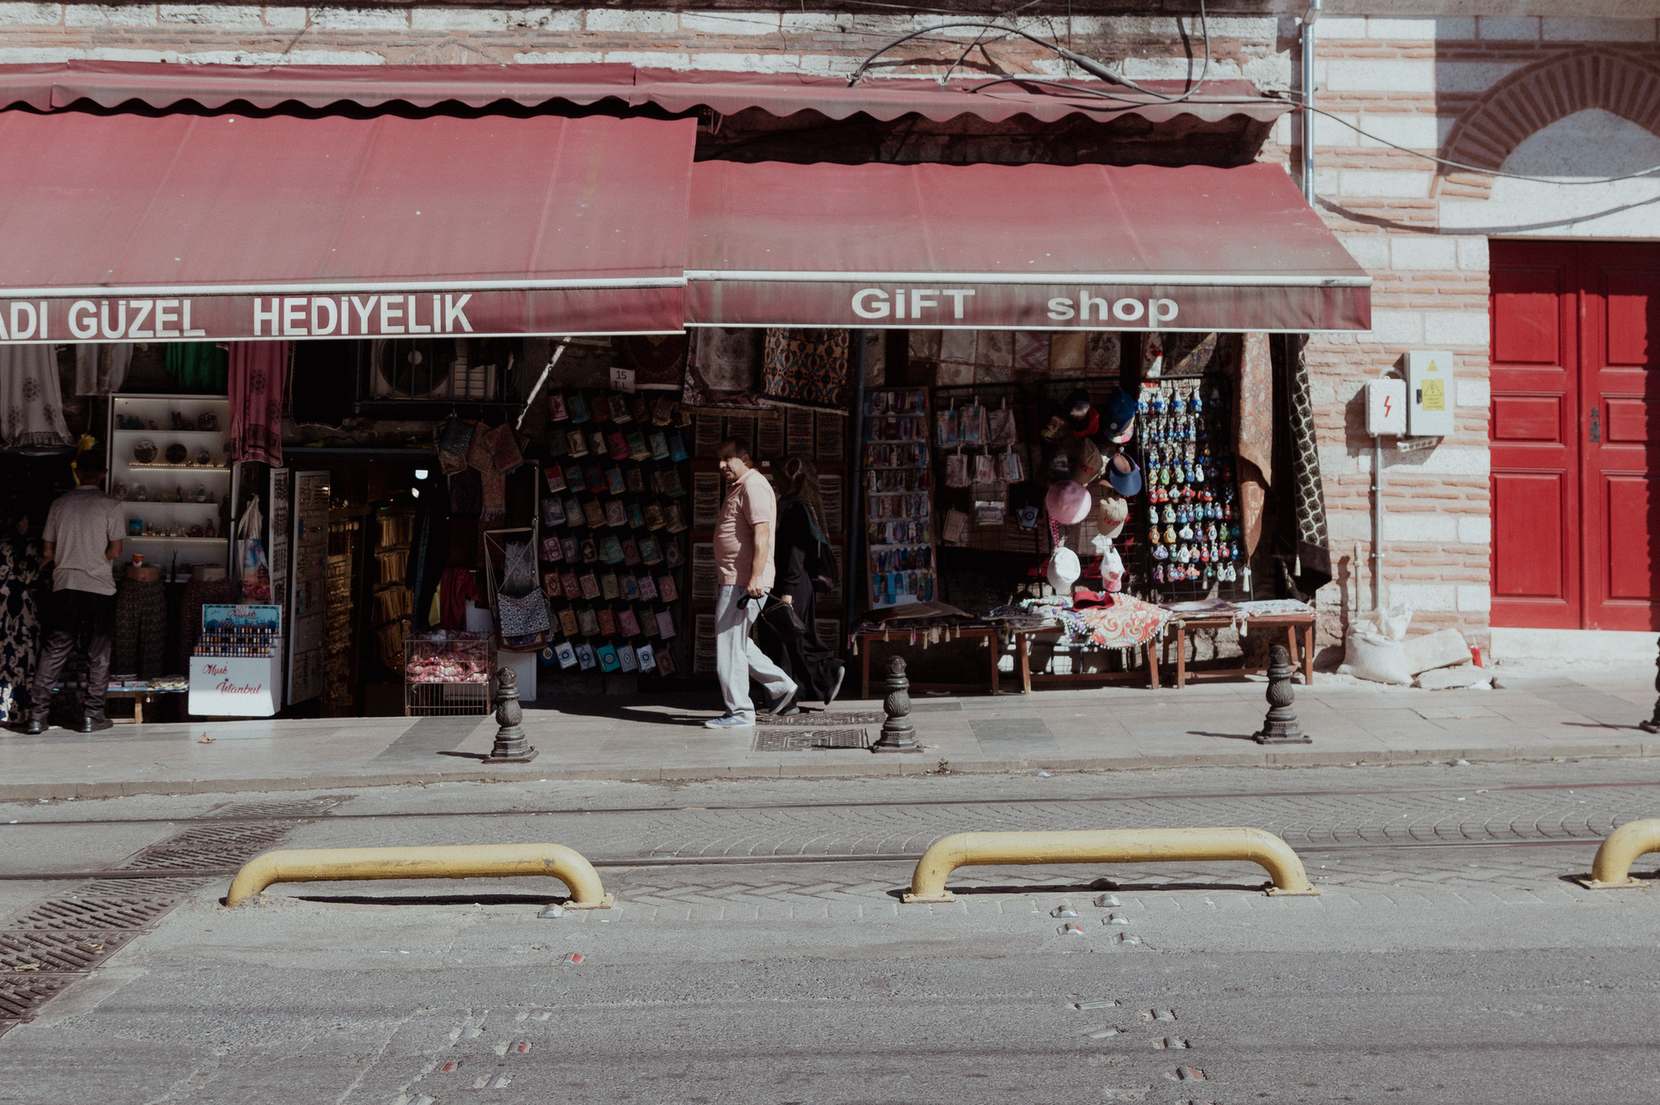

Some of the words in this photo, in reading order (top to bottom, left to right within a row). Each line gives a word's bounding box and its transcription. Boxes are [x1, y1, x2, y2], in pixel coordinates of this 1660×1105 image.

[0, 300, 49, 340] DI
[68, 299, 206, 339] GÜZEL
[1047, 290, 1179, 328] shop
[616, 370, 627, 380] 15
